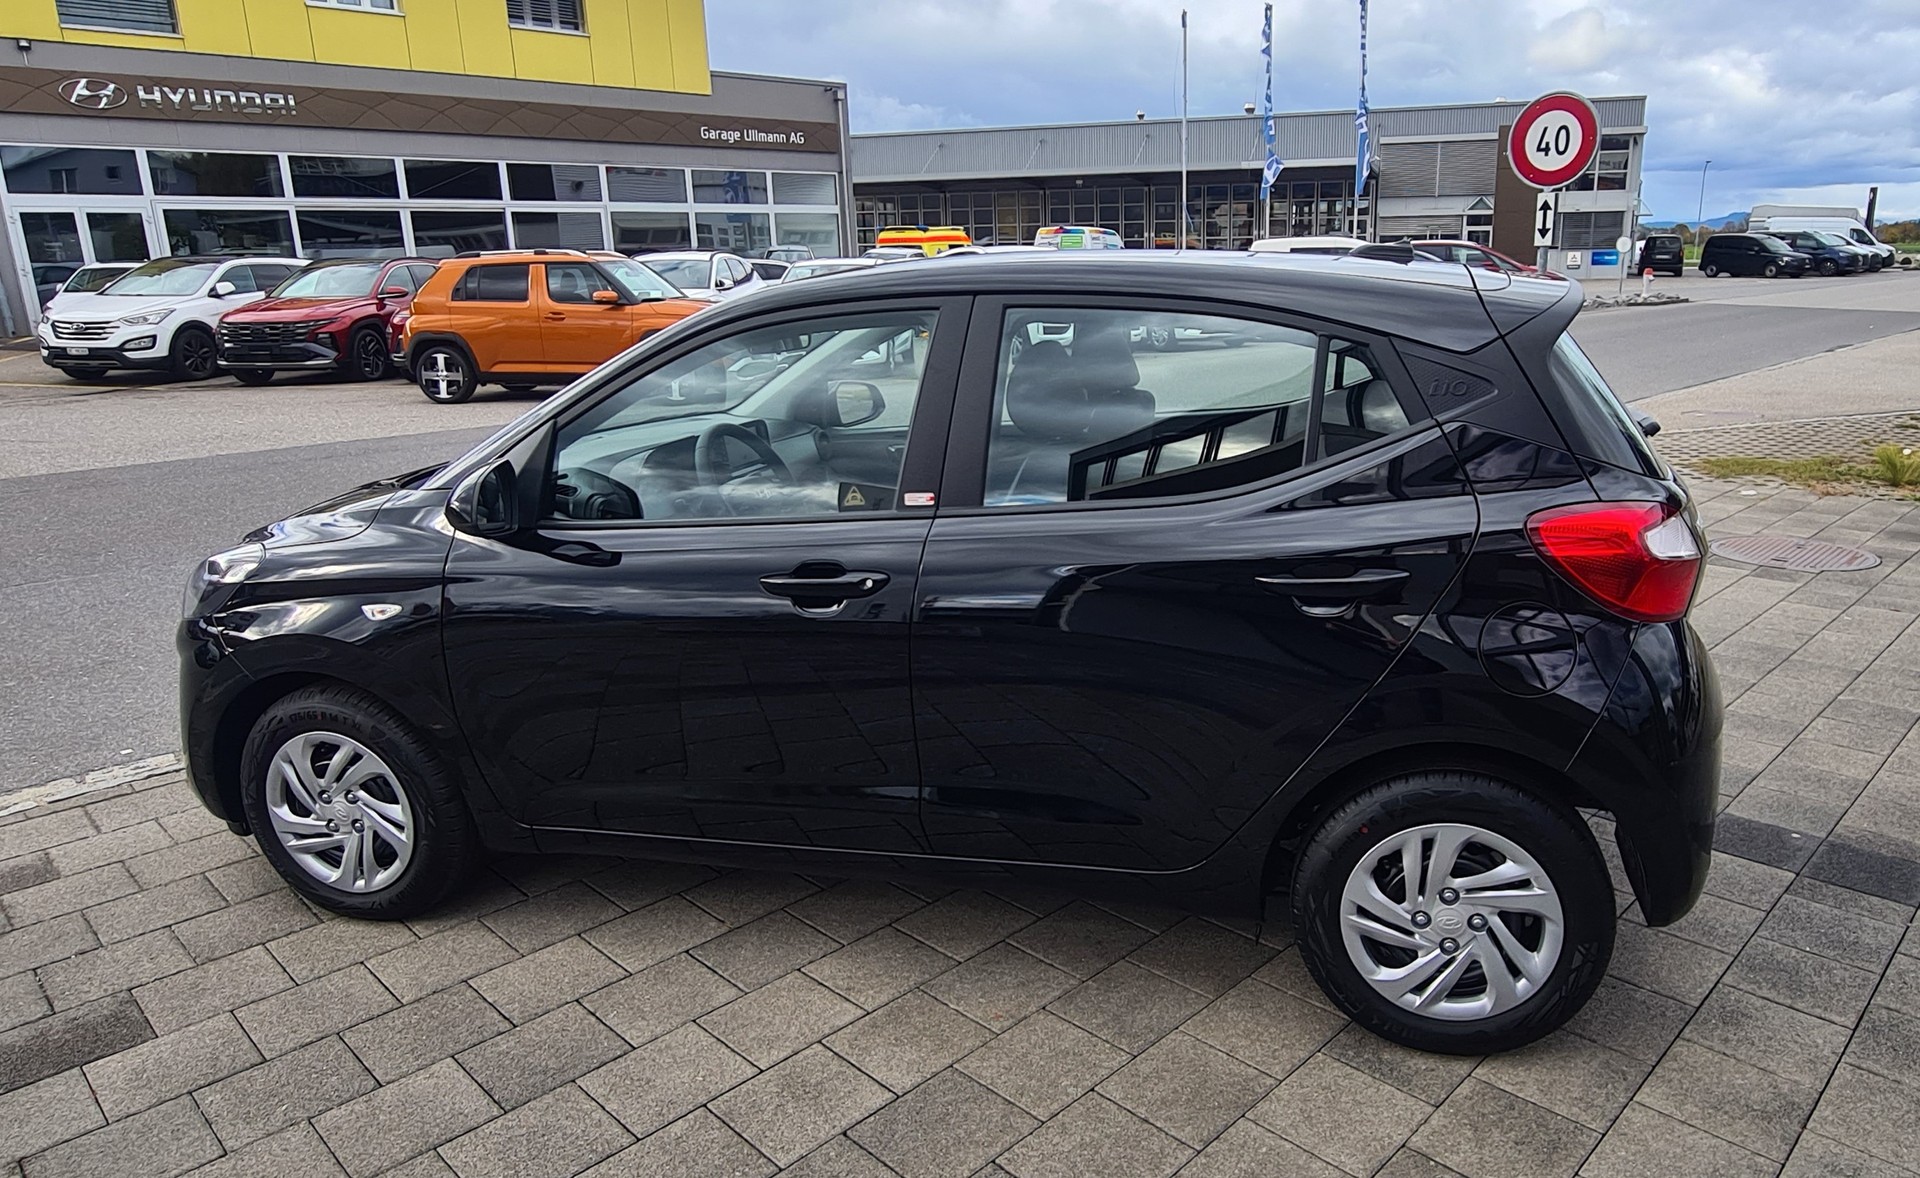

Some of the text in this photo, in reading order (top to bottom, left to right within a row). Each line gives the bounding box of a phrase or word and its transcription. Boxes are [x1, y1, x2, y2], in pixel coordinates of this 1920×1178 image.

[136, 85, 297, 115] HYUNDAI
[700, 126, 805, 144] Garage Ullmann AG
[1536, 124, 1571, 157] 40
